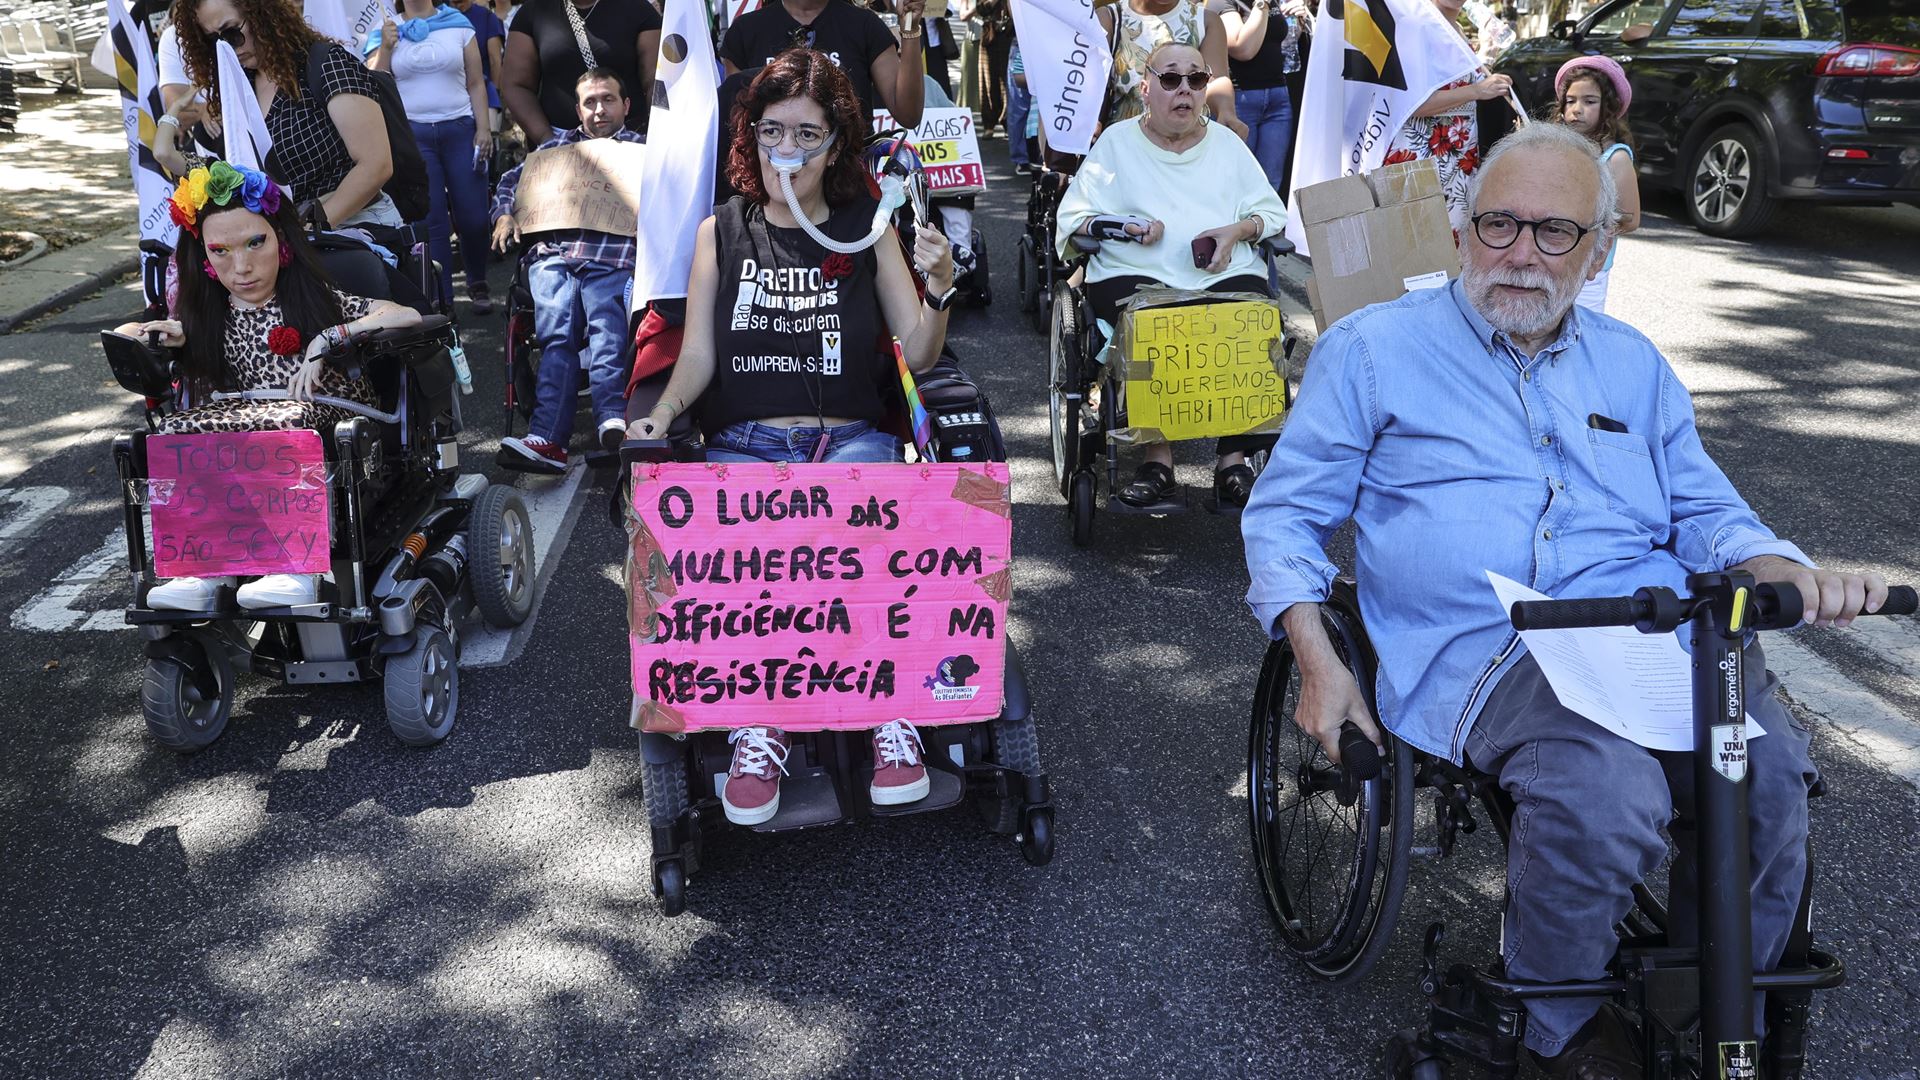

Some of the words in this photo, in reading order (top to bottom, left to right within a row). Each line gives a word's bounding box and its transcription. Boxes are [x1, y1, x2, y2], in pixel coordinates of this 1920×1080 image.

[930, 166, 966, 188] MAIS
[750, 314, 768, 330] se
[773, 313, 841, 334] discutem
[1135, 312, 1217, 344] LARES
[1234, 303, 1274, 334] SÃO
[1149, 370, 1277, 400] QUEREMOS
[165, 442, 297, 476] TODOS
[658, 486, 694, 529] O
[716, 485, 833, 526] LUGAR
[847, 495, 900, 530] DAS
[160, 535, 213, 563] SÃO
[227, 523, 318, 566] SEXY
[888, 546, 983, 578] COM
[887, 584, 918, 639] É
[948, 603, 996, 639] NA
[1726, 652, 1739, 717] ergométrica
[1723, 741, 1745, 752] UNA
